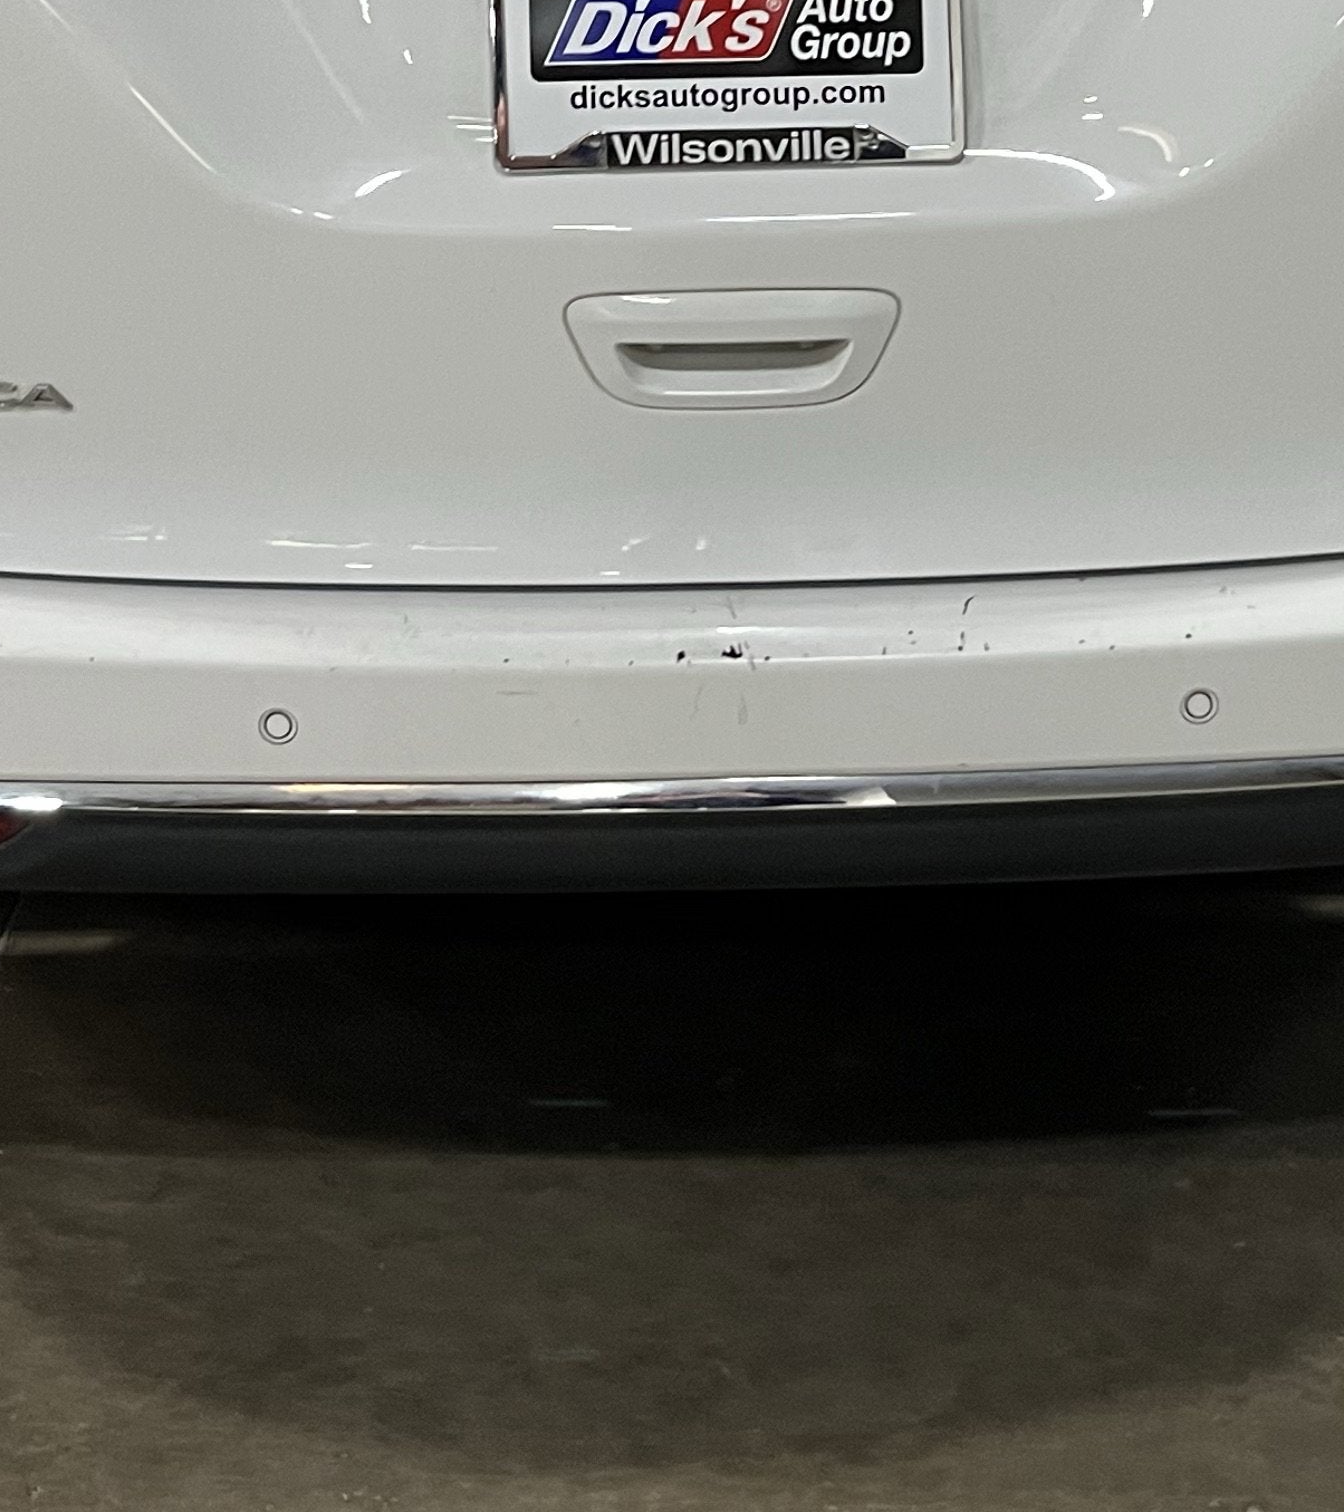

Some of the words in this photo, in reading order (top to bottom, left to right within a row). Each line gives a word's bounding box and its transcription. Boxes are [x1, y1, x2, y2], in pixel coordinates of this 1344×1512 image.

[790, 28, 912, 66] Group
[570, 84, 886, 112] dicksautogroup.com
[611, 129, 851, 166] Wilsonville
